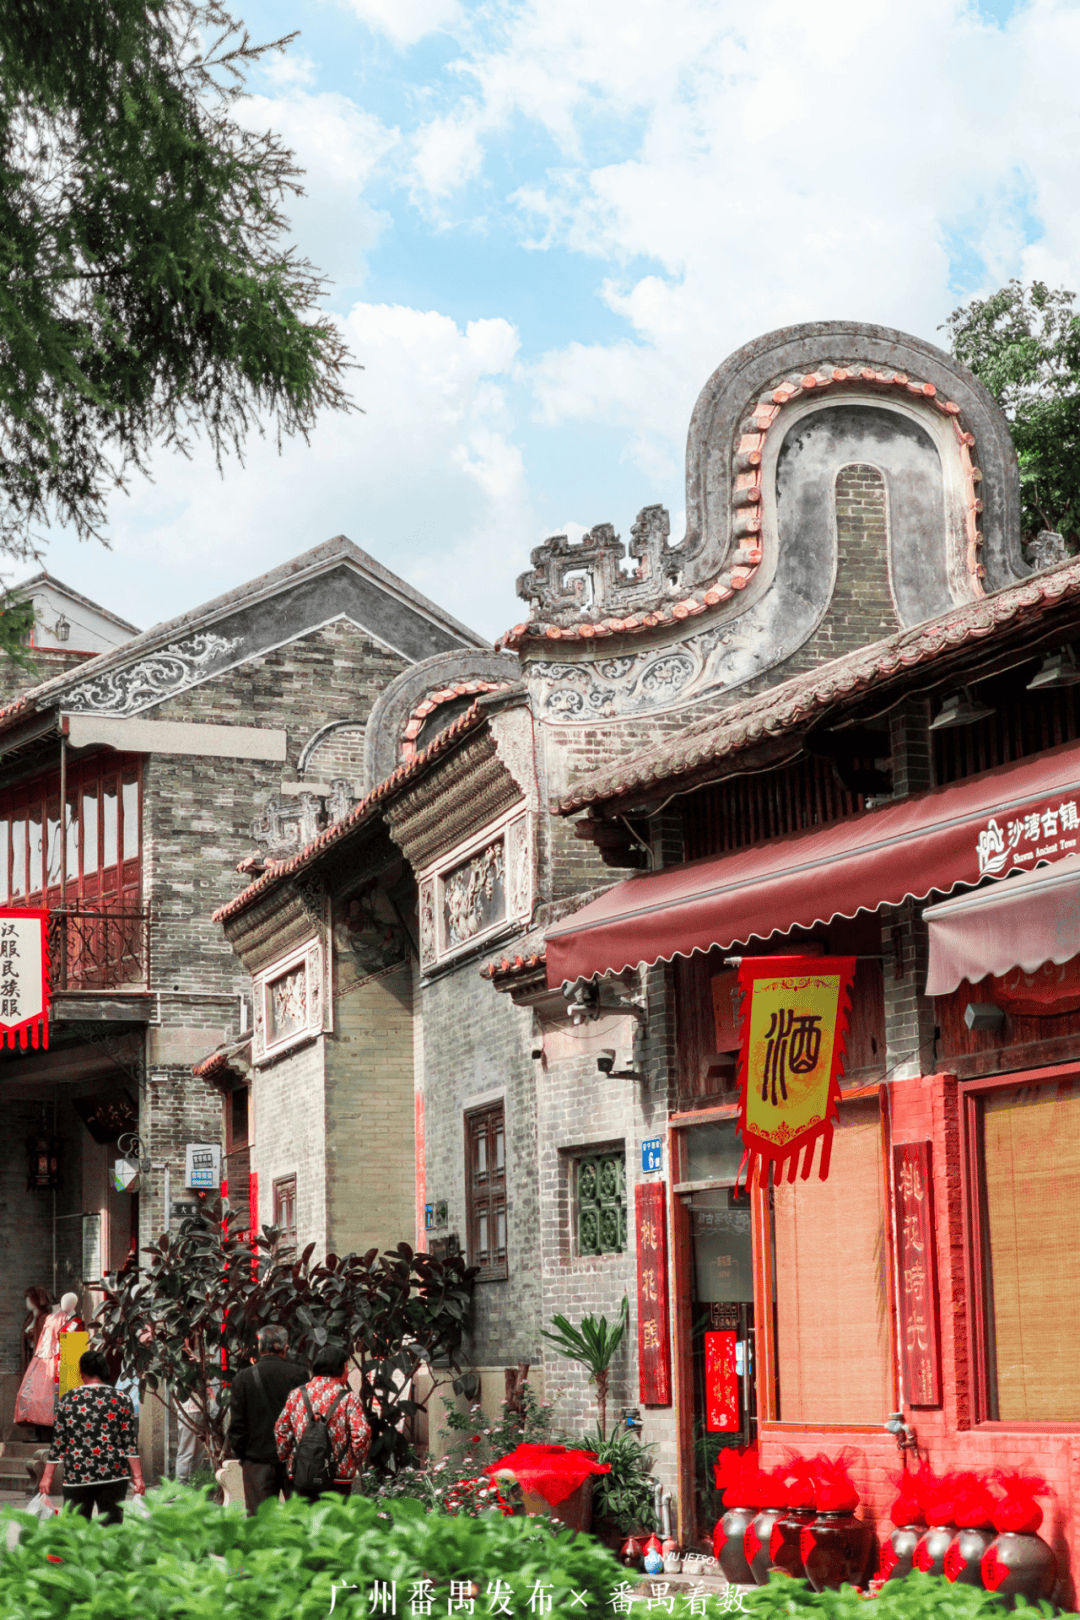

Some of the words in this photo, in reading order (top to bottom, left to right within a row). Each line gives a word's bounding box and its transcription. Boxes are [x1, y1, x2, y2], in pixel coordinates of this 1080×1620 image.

[1007, 800, 1080, 848] 沙湾古镇
[1036, 843, 1058, 857] Ancient
[1060, 839, 1077, 850] Town
[762, 1008, 822, 1106] 酒
